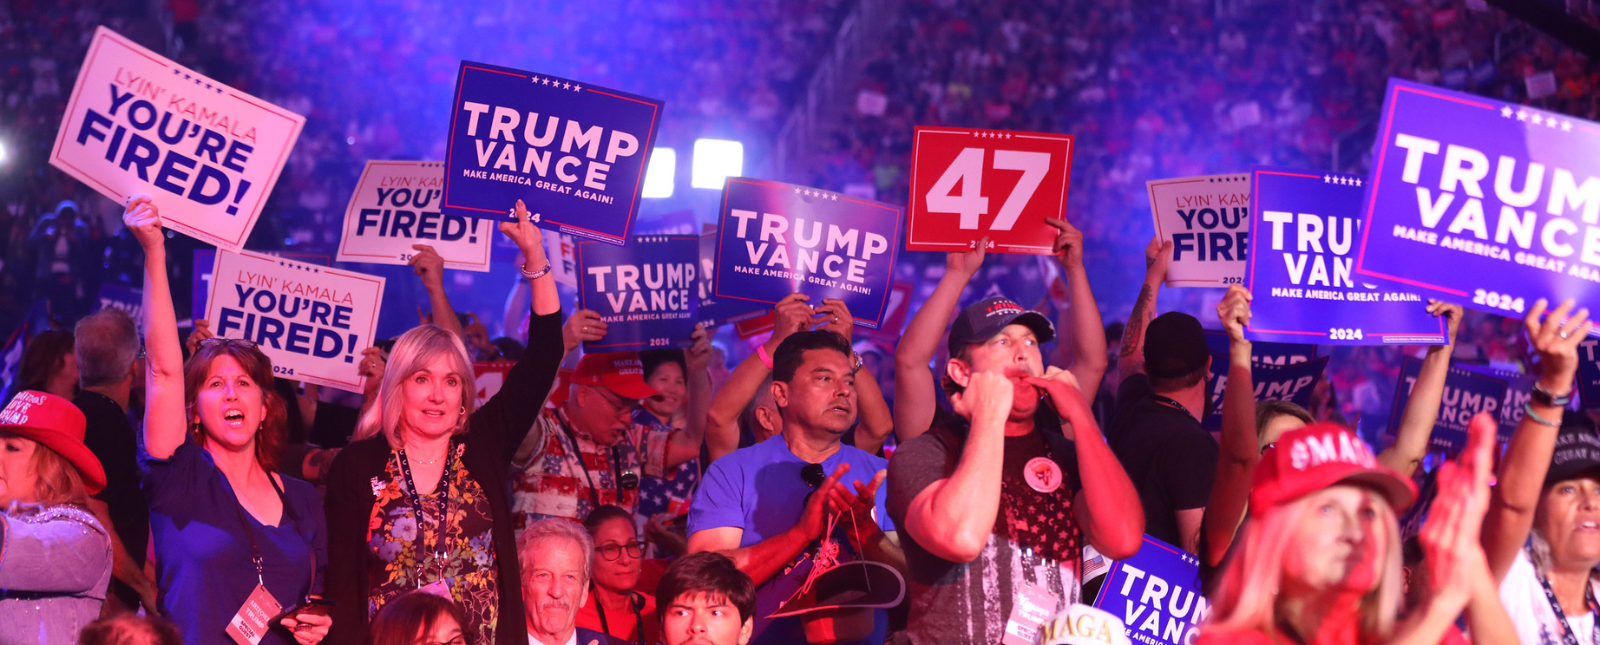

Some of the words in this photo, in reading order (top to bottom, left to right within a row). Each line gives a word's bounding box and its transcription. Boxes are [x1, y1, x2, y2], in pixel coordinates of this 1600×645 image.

[114, 67, 166, 101] LYIN'
[168, 93, 257, 144] KAMALA
[108, 83, 254, 174] YOU'RE
[464, 101, 639, 164] TRUMP
[76, 108, 252, 217] FIRED!
[475, 139, 610, 191] VANCE
[1394, 133, 1600, 225] TRUM
[377, 187, 441, 209] YOU'
[380, 176, 416, 187] LYIN'
[419, 177, 445, 187] KAM
[463, 169, 487, 179] MAKE
[489, 173, 532, 186] AMERICA
[535, 181, 572, 195] GREAT
[574, 189, 614, 205] AGAIN!
[925, 147, 1051, 231] 47
[509, 208, 541, 224] 224
[1175, 195, 1213, 208] LYIN'
[1218, 193, 1251, 206] KAM
[356, 209, 479, 244] FIRED!
[731, 208, 889, 261] TRUMP
[1176, 207, 1248, 230] YOU'
[1262, 210, 1361, 255] TRU
[400, 253, 413, 262] 20
[745, 241, 868, 284] VANCE
[969, 241, 995, 249] 224
[1172, 232, 1248, 262] FIRE
[1393, 225, 1437, 245] MAKE
[1440, 235, 1511, 261] AMERICA
[1514, 252, 1566, 273] GREAT
[1568, 263, 1600, 283] AGA
[237, 269, 278, 288] LYIN'
[281, 279, 354, 305] KAMALA
[587, 263, 696, 293] TRUMP
[734, 265, 760, 275] MAKE
[763, 269, 806, 282] AMERICA
[808, 276, 838, 288] GREAT
[839, 282, 872, 296] AGAIN!
[1283, 252, 1377, 290] VAN
[234, 283, 354, 330] YOU'RE
[606, 290, 689, 314] VANCE
[1271, 287, 1302, 297] MAKE
[1305, 289, 1344, 301] AMERICA
[1346, 291, 1380, 302] GREAT
[1383, 291, 1421, 302] AGAIN!
[1472, 288, 1525, 314] 2024
[216, 306, 358, 364] FIRED!
[600, 315, 624, 323] MAKE
[626, 314, 660, 322] AMERICA
[1329, 328, 1363, 341] 2024
[650, 338, 670, 347] 2024
[272, 364, 294, 376] 024
[1405, 376, 1498, 413] TUMP
[1120, 563, 1214, 625] TRUM
[1039, 613, 1112, 645] MAGA
[1125, 598, 1201, 645] VANC
